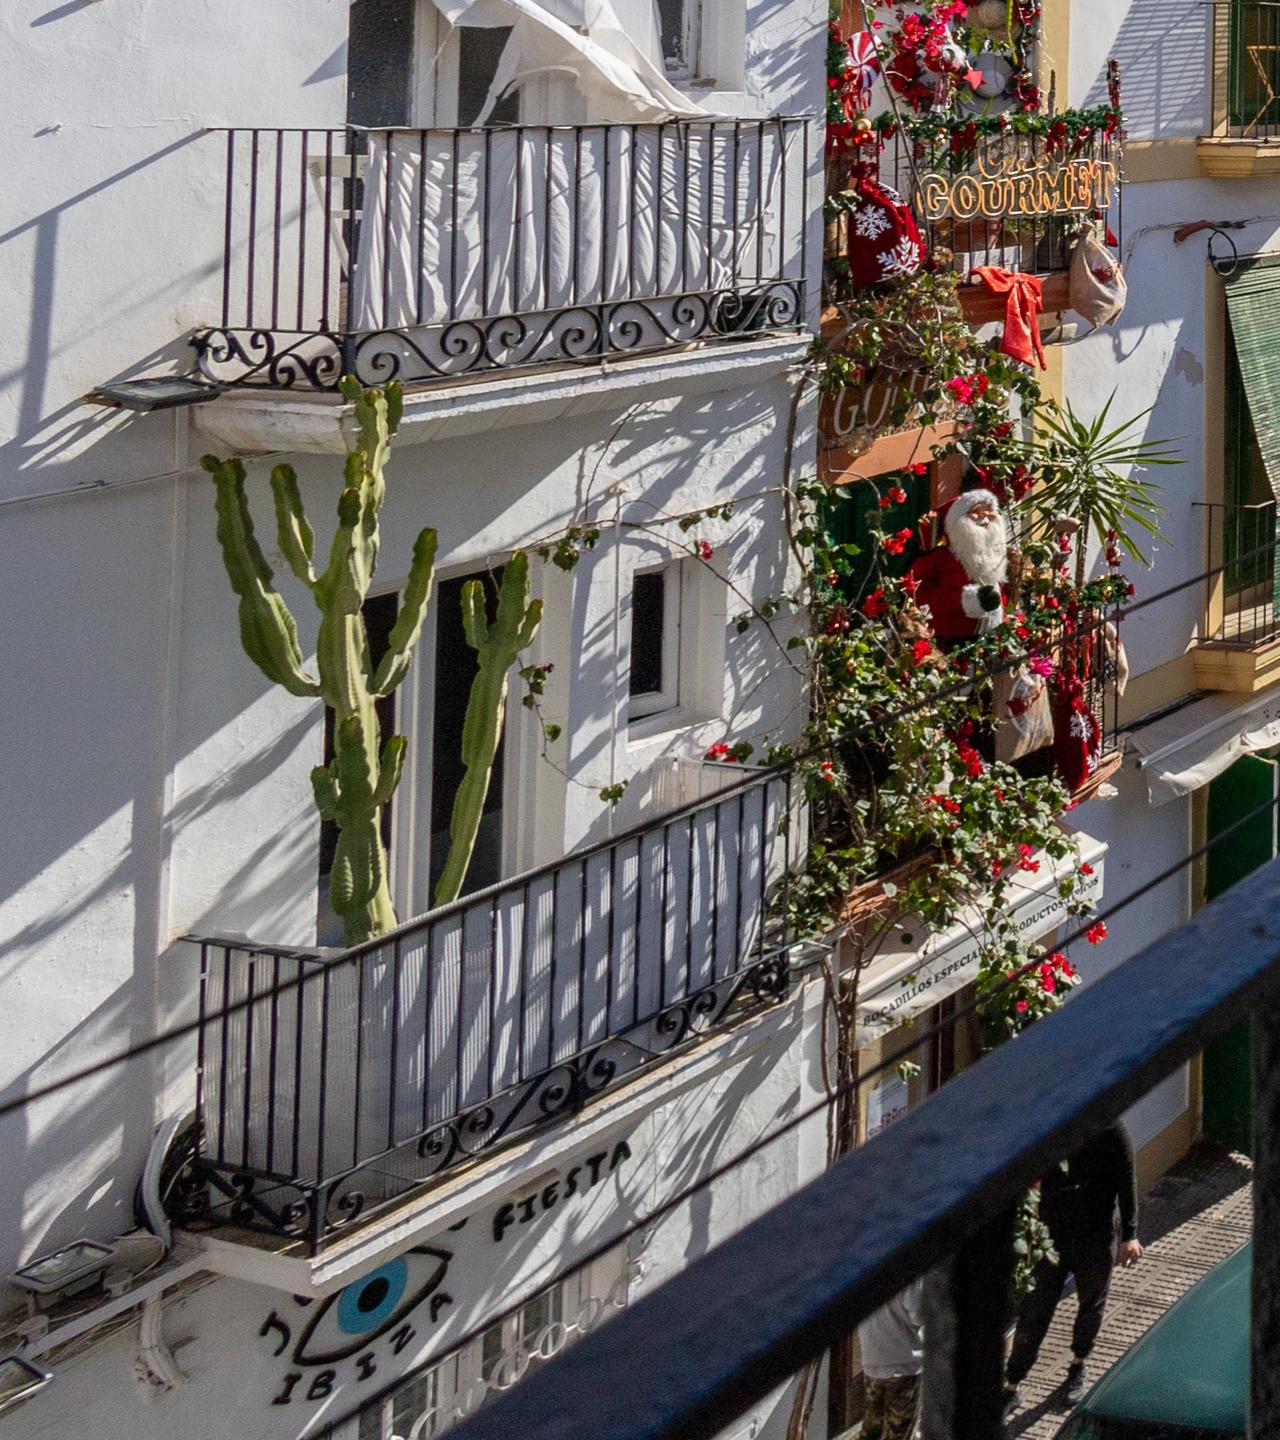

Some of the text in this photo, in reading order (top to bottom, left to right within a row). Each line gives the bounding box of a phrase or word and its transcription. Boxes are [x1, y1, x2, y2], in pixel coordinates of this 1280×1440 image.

[916, 158, 1116, 220] GOURMET
[863, 977, 933, 1027] BOCADILLOS
[493, 1140, 633, 1242] FIESTA
[272, 1292, 455, 1406] IBIZA
